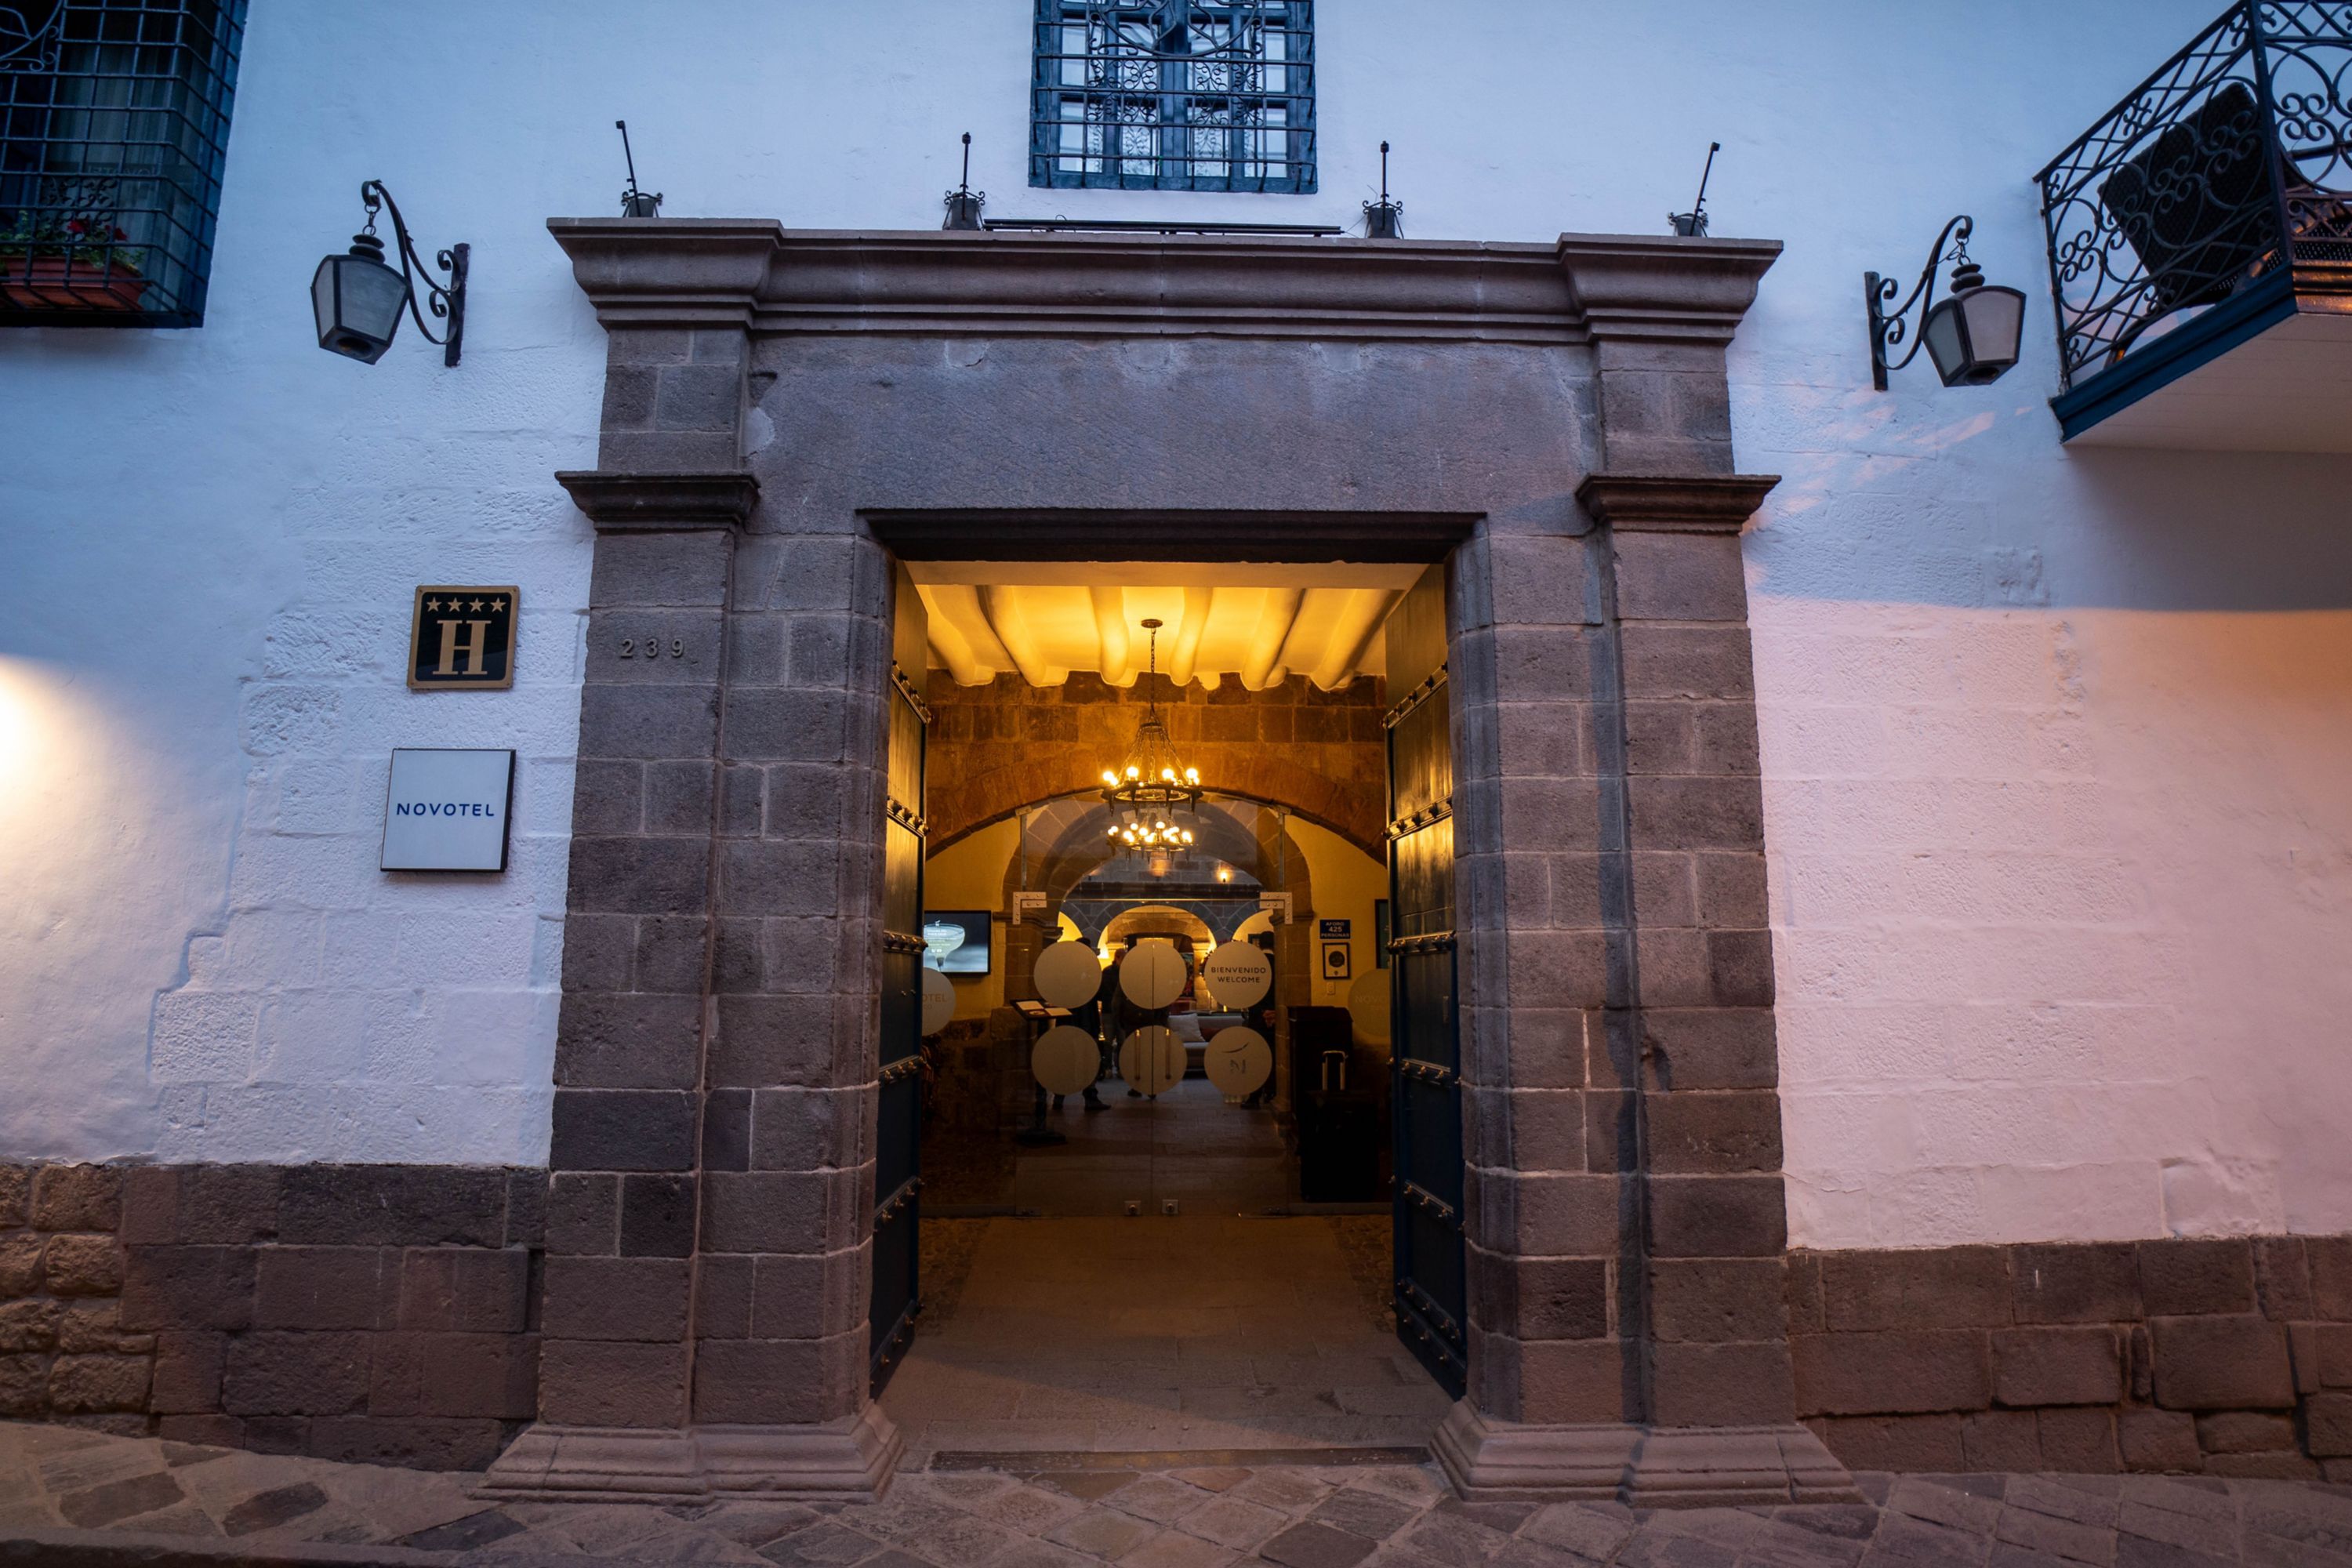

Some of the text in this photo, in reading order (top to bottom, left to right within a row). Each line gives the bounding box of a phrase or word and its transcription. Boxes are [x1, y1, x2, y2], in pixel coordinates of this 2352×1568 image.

[432, 619, 492, 675] H
[621, 638, 684, 658] 239
[396, 802, 495, 817] NOVOTEL
